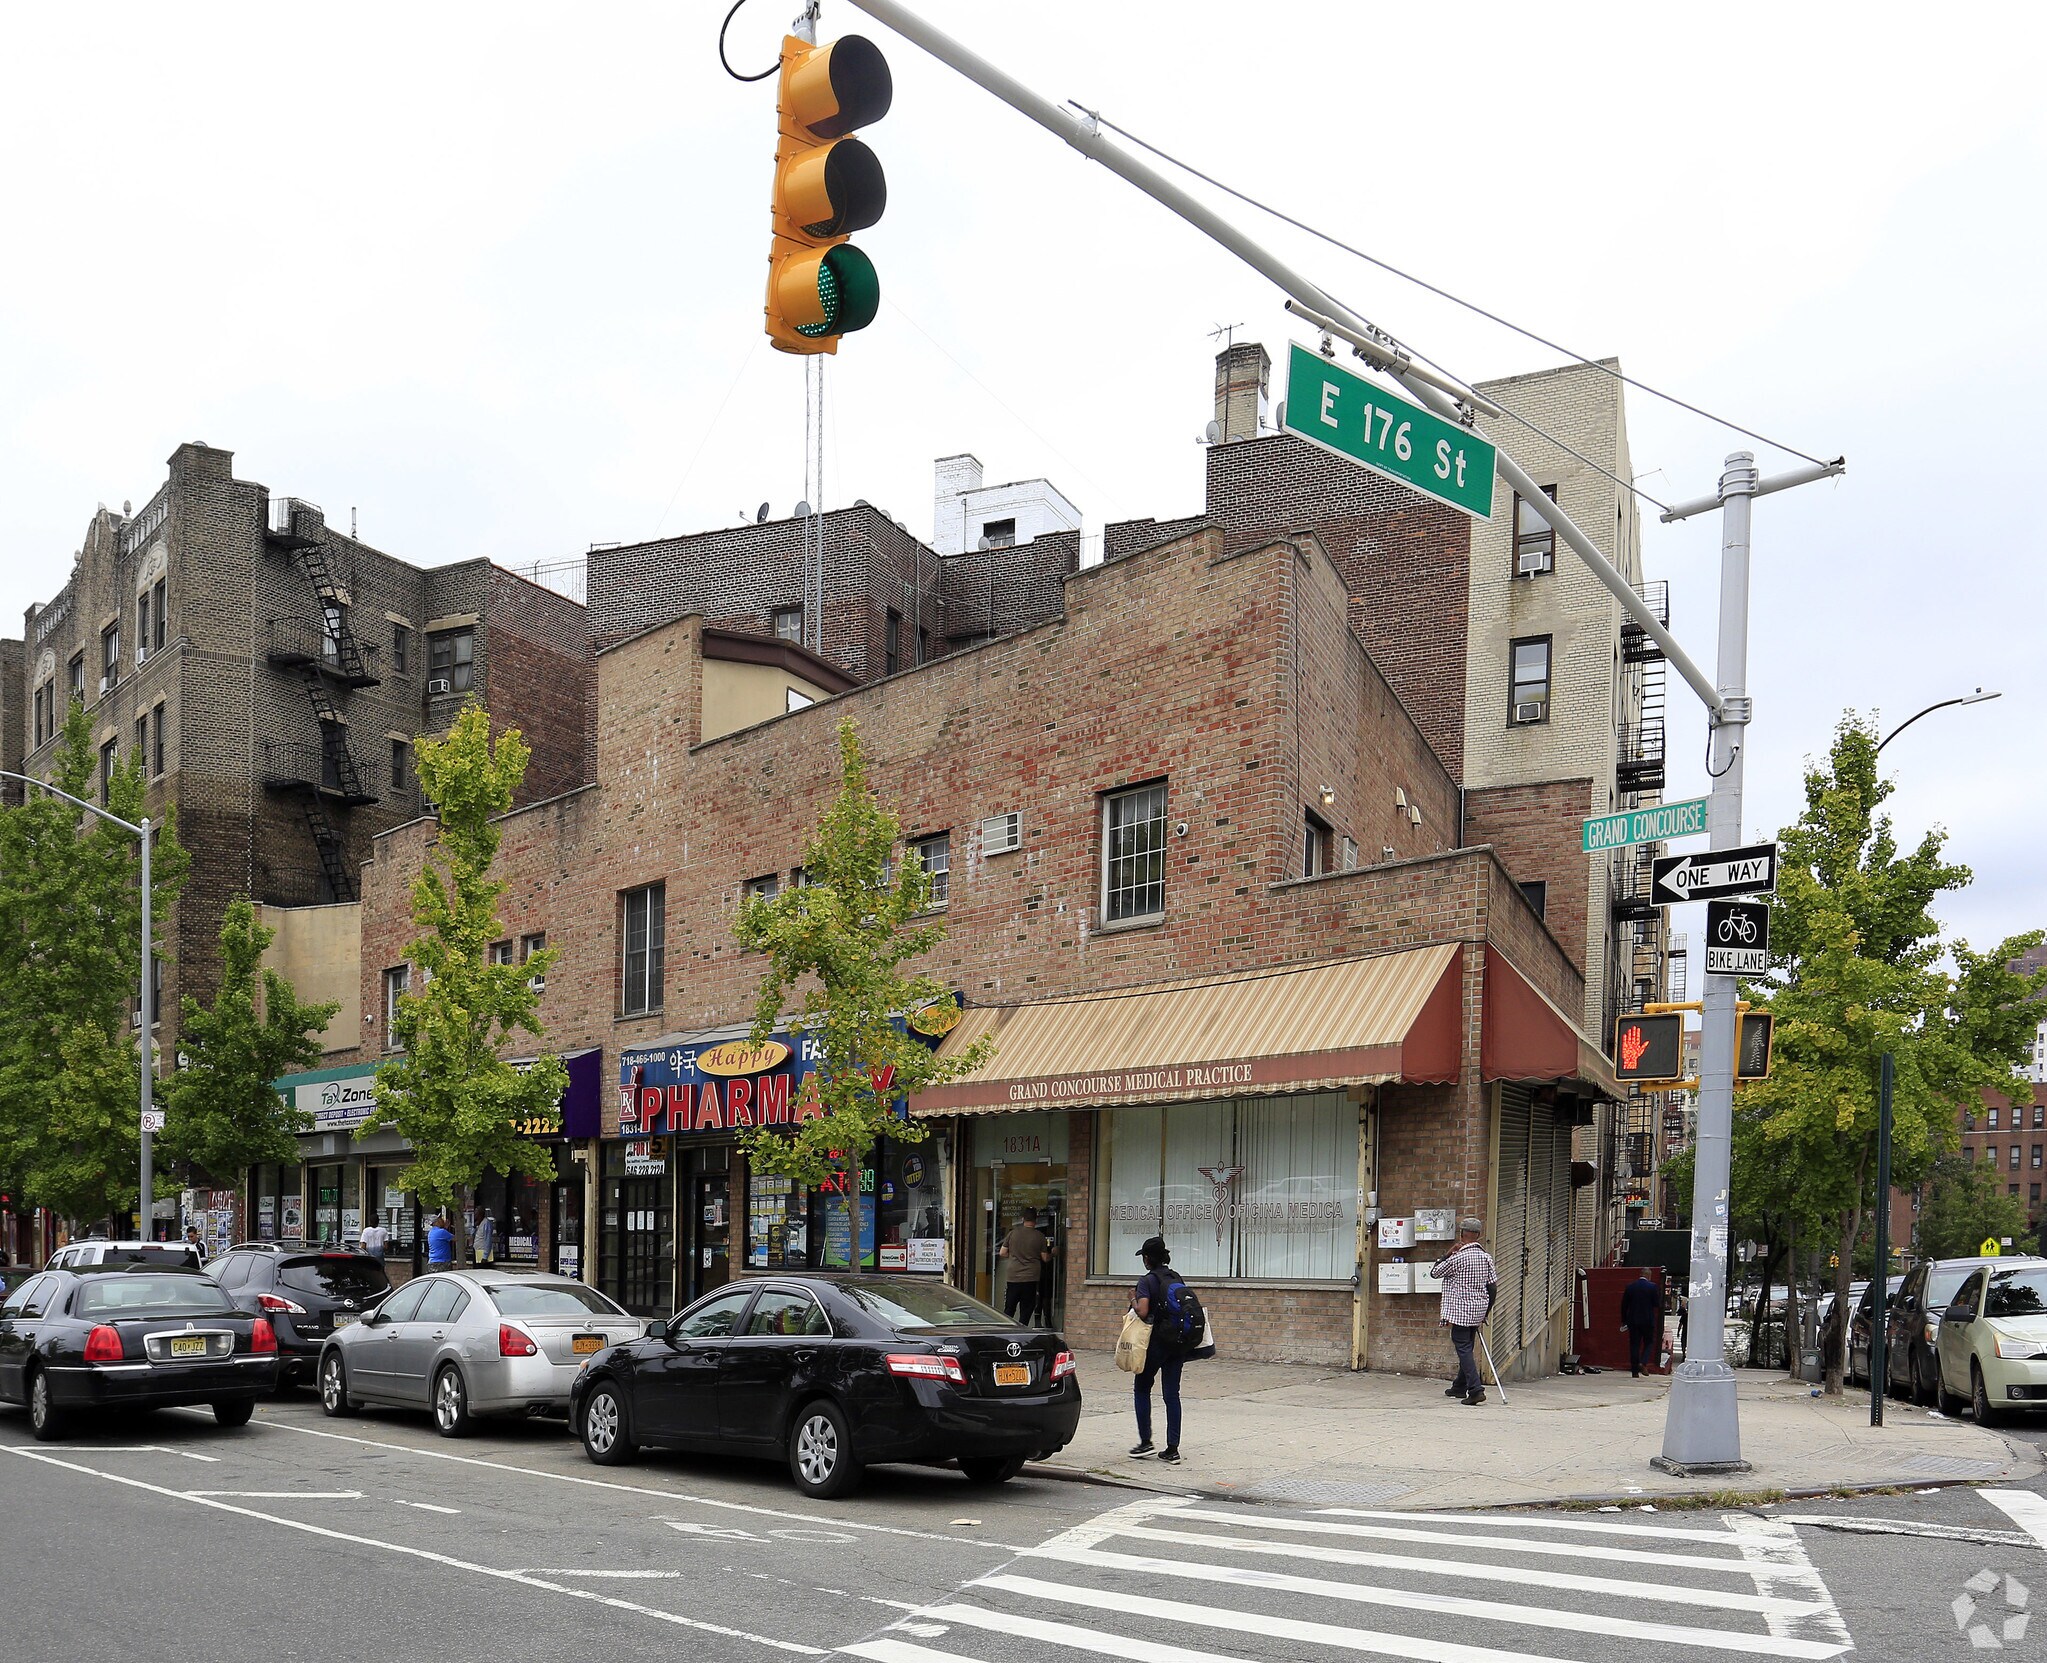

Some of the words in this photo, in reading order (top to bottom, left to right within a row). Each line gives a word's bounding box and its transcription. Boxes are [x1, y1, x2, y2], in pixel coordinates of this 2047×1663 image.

[1320, 380, 1340, 429] E
[1363, 402, 1412, 461] 176
[1434, 439, 1467, 488] St
[1588, 817, 1628, 848] GRAND
[1633, 803, 1703, 840] CONCOURSE
[1676, 868, 1710, 888] ONE
[1728, 860, 1763, 882] WAY
[1708, 952, 1733, 970] BIKE
[1737, 953, 1764, 971] LANE
[621, 1051, 666, 1067] 718-466-1000
[669, 1050, 698, 1079] 약국
[706, 1048, 776, 1070] Happy
[1009, 1082, 1048, 1100] GRAND
[1051, 1076, 1122, 1098] CONCOURSE
[1124, 1070, 1182, 1091] MEDICAL
[1186, 1064, 1252, 1087] PRACTICE
[641, 1065, 897, 1133] PHARMAY
[621, 1124, 643, 1134] 1831-
[1003, 1135, 1041, 1153] 1831A
[1109, 1204, 1162, 1221] MEDICAL
[1166, 1204, 1212, 1220] OFFICE
[1228, 1203, 1284, 1219] OFICINA
[1287, 1202, 1344, 1219] MEDICA
[508, 1236, 533, 1247] MEDICAL
